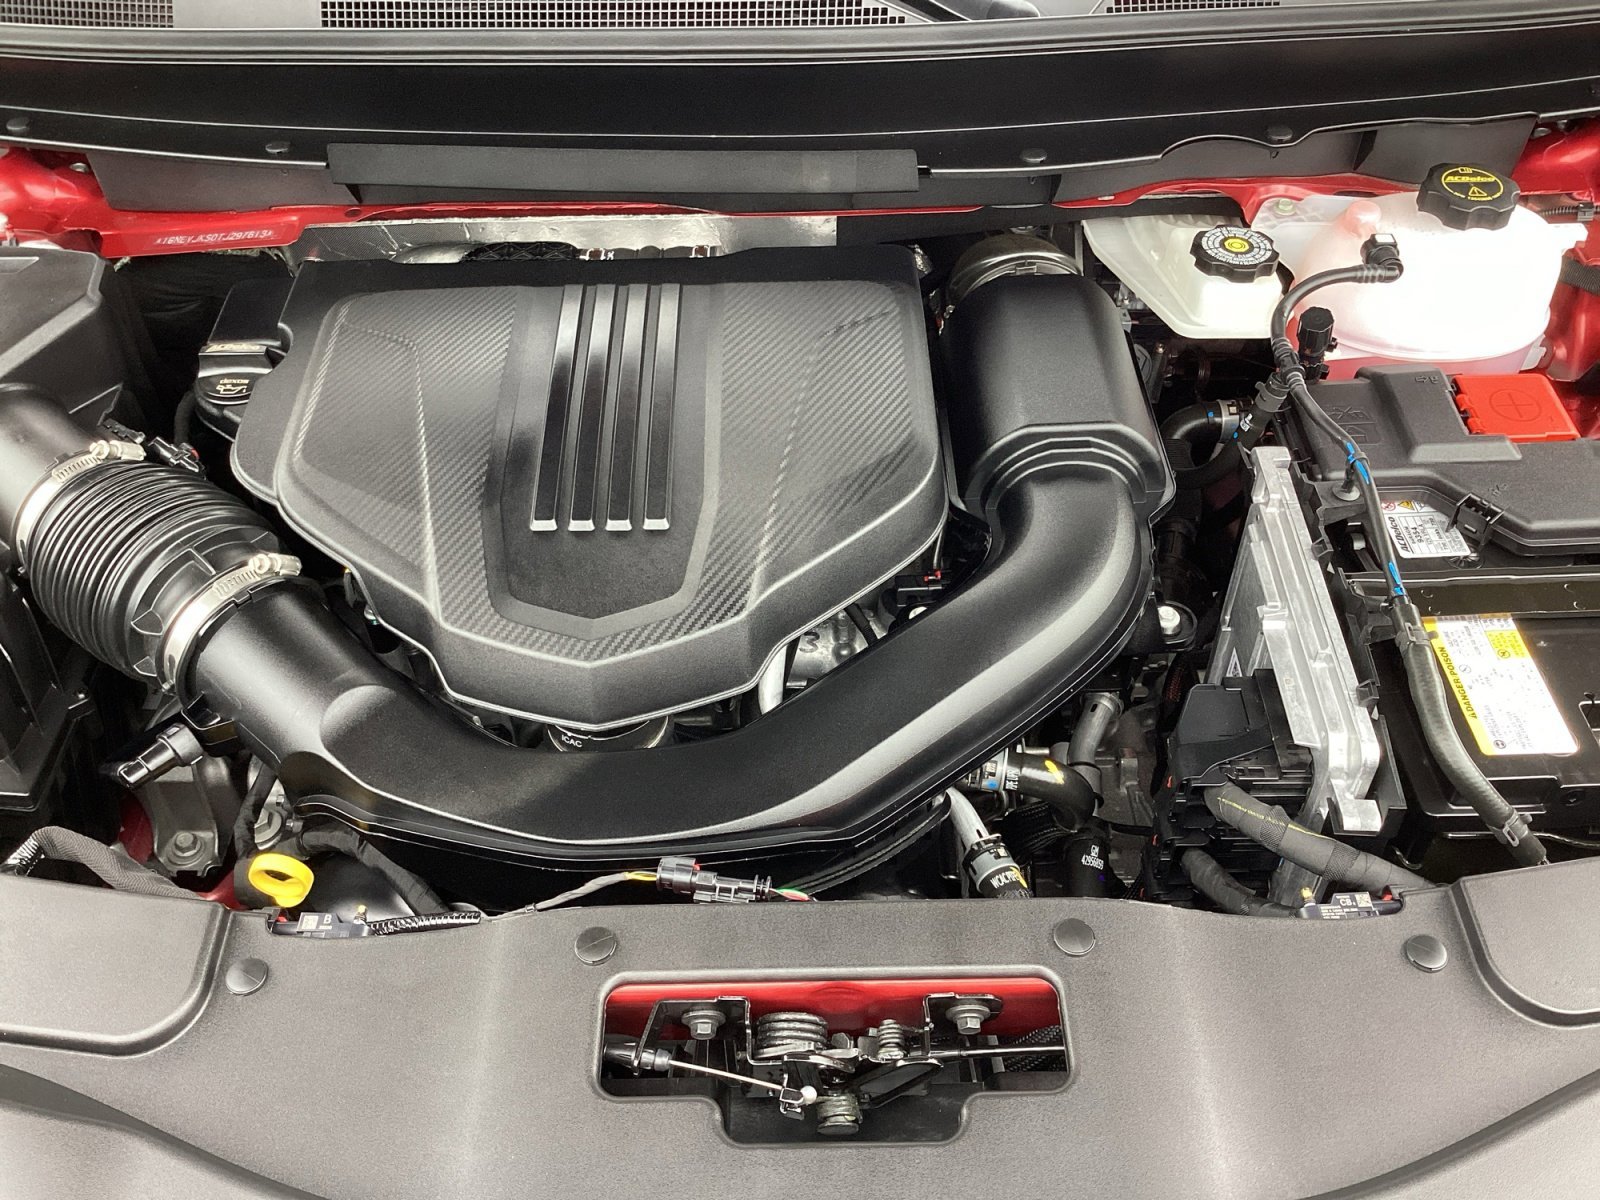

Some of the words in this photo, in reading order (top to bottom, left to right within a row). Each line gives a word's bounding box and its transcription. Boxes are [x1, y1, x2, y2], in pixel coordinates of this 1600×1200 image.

[1444, 175, 1496, 183] ACDelco
[1387, 516, 1411, 553] ACDelco
[561, 734, 583, 748] ICAC
